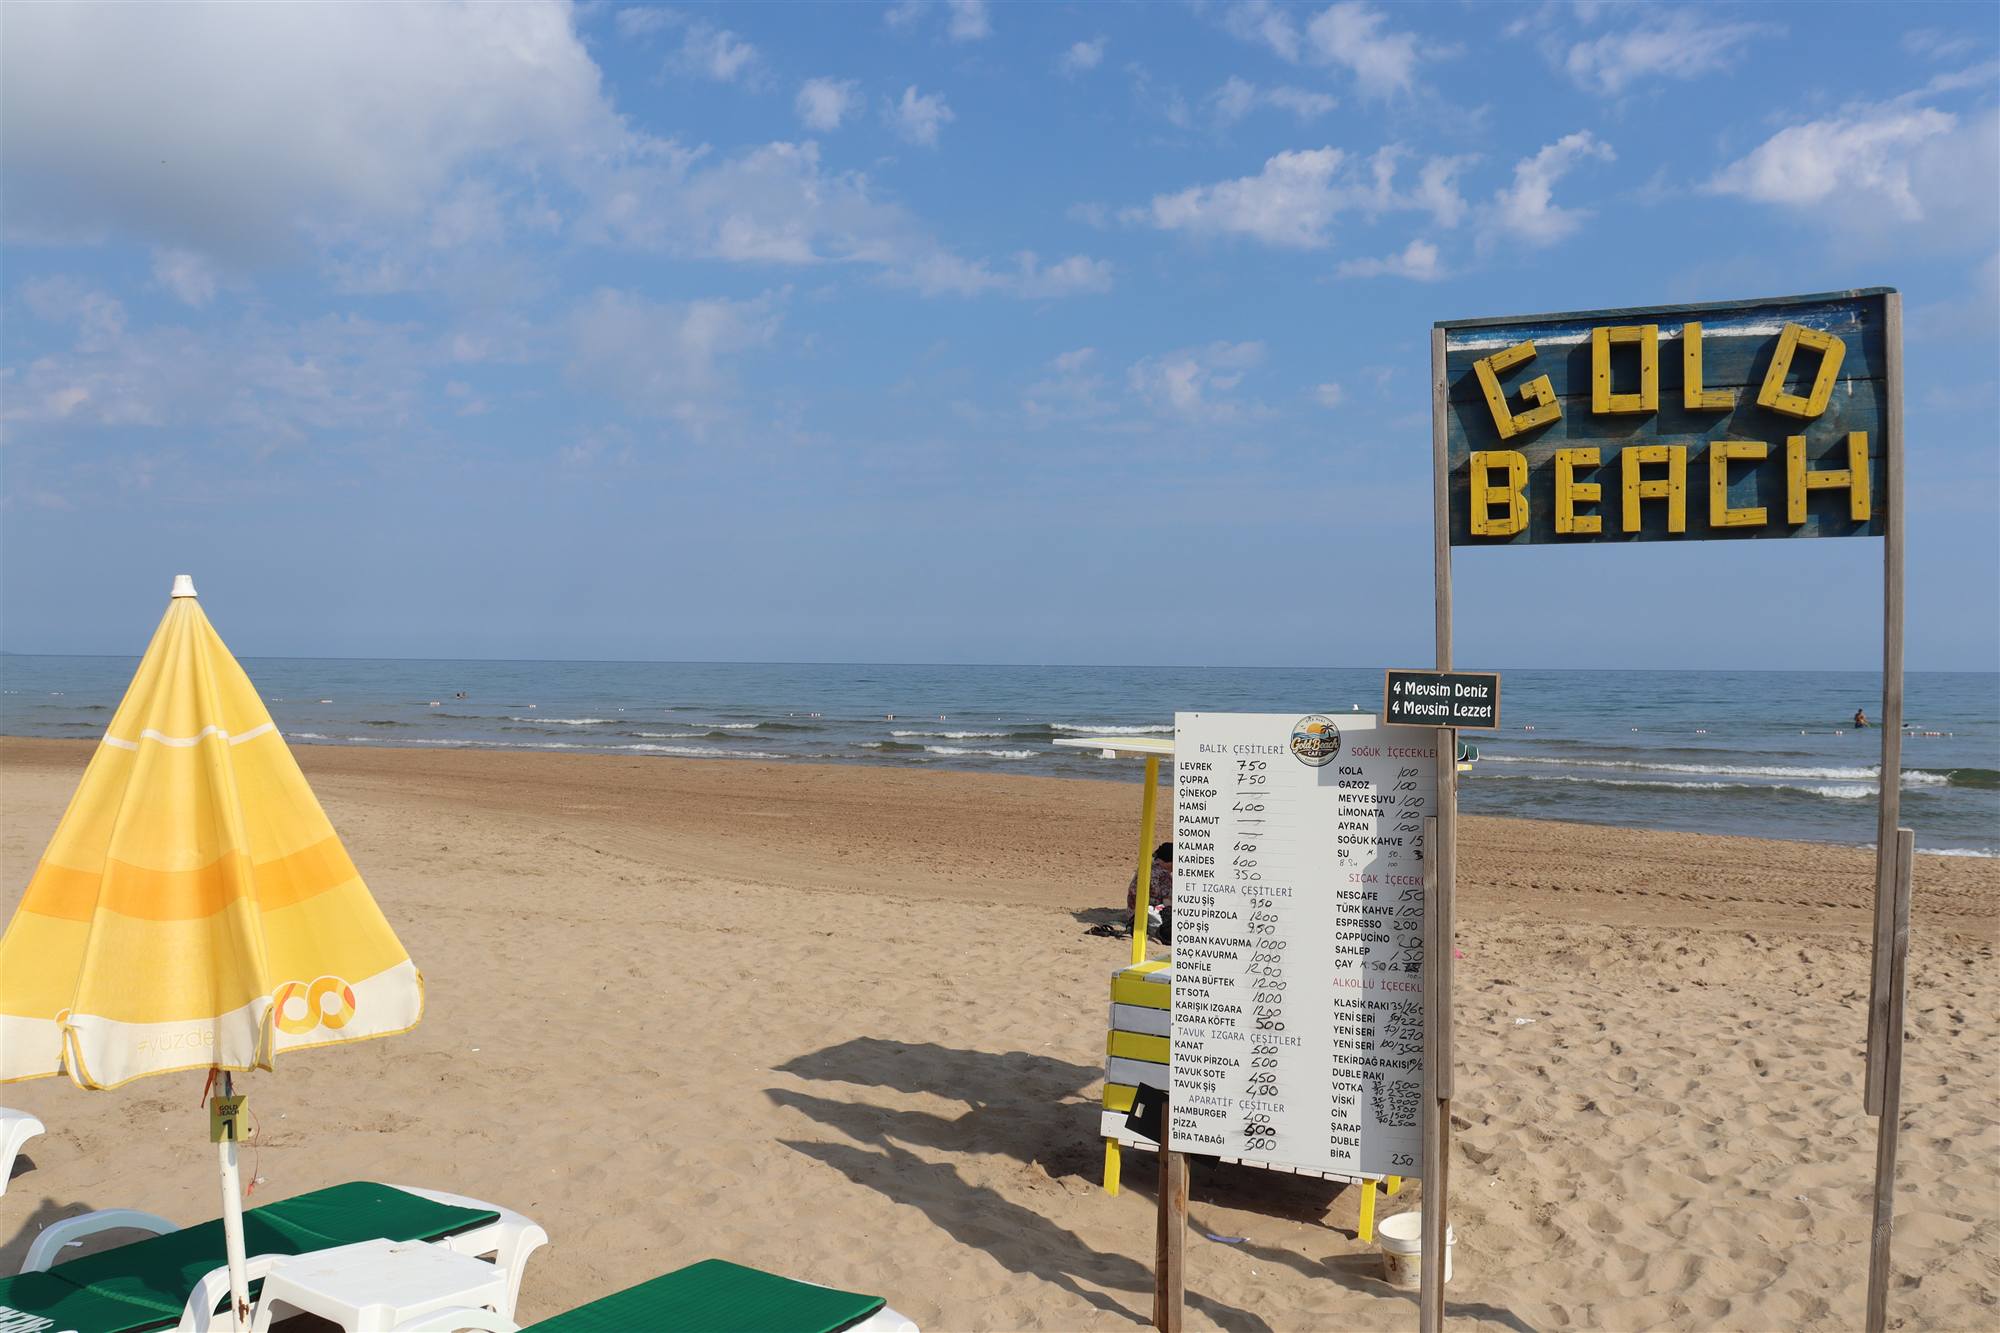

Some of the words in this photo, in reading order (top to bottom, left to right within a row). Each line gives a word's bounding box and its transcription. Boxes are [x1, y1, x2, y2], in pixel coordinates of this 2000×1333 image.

[1473, 320, 1846, 440] GOLD
[1470, 430, 1871, 537] BEACH
[1393, 681, 1401, 695] 4
[1405, 681, 1451, 697] Mevsim
[1455, 683, 1488, 698] Deniz
[1392, 700, 1400, 714] 4
[1403, 701, 1449, 716] Mevsim
[1453, 702, 1492, 718] Lezzet
[1200, 744, 1227, 753] BALIK
[1233, 743, 1284, 756] ÇEŞİTLERİ
[1352, 747, 1380, 757] SOĞUK
[1387, 747, 1438, 758] İÇECEKLE
[1180, 762, 1212, 771] LEVREK
[1237, 760, 1267, 771] 750
[1180, 775, 1209, 785] ÇUPRA
[1237, 773, 1266, 785] 750
[1338, 767, 1363, 776] KOLA
[1397, 767, 1418, 779] 100
[1338, 780, 1370, 790] GAZOZ
[1393, 781, 1417, 792] 100
[1180, 787, 1217, 798] ÇİNEKOP
[1338, 794, 1369, 803] MEYVE
[1371, 795, 1396, 804] SUYU
[1398, 795, 1425, 807] 100
[1179, 801, 1207, 811] HAMSİ
[1232, 801, 1264, 813] 400
[1338, 806, 1385, 818] LİMONATA
[1395, 809, 1420, 819] 100
[1179, 815, 1220, 825] PALAMUT
[1179, 828, 1211, 838] SOMON
[1338, 822, 1369, 831] AYRAN
[1393, 822, 1419, 832] 100
[1337, 834, 1369, 845] SOĞUK
[1371, 837, 1403, 846] KAHVE
[1178, 842, 1214, 851] KALMAR
[1233, 841, 1257, 852] 600
[1337, 849, 1350, 858] SU
[1178, 854, 1215, 865] KARİDES
[1233, 855, 1257, 867] 600
[1178, 868, 1215, 878] B.EKMEK
[1233, 869, 1261, 880] 350
[1349, 873, 1378, 884] SICAK
[1185, 882, 1197, 892] ET
[1203, 883, 1236, 894] IZGARA
[1177, 895, 1200, 904] KUZU
[1202, 895, 1215, 907] ŞİŞ
[1336, 891, 1378, 901] NESCAFE
[1177, 908, 1200, 918] KUZU
[1201, 908, 1238, 920] PİRZOLA
[1336, 903, 1360, 914] TÜRK
[1362, 906, 1394, 916] KAHVE
[1177, 920, 1195, 932] ÇÖP
[1196, 921, 1210, 933] ŞİŞ
[1336, 918, 1382, 929] ESPRESSO
[1393, 920, 1418, 930] 200
[1177, 935, 1207, 945] ÇOBAN
[1208, 937, 1252, 948] KAVURMA
[1256, 938, 1287, 950] 1000
[1335, 932, 1390, 943] CAPPUCİNO
[1176, 948, 1194, 958] SAÇ
[1195, 950, 1238, 960] KAVURMA
[1251, 951, 1281, 963] 1000
[1335, 946, 1371, 955] SAHLEP
[1176, 961, 1212, 972] BONFİLE
[1245, 963, 1282, 978] 1200
[1335, 960, 1353, 969] ÇAY
[1176, 975, 1200, 984] DANA
[1202, 975, 1235, 987] BÜFTEK
[1252, 978, 1287, 990] 1200
[1333, 977, 1375, 989] ALKOLLÜ
[1381, 979, 1422, 992] İÇECEKL
[1176, 988, 1186, 996] ET
[1187, 988, 1210, 998] SOTA
[1175, 1001, 1209, 1012] KARIŞIK
[1210, 1003, 1242, 1014] IZGARA
[1334, 998, 1365, 1009] KLASİK
[1368, 1001, 1389, 1010] RAKI
[1175, 1014, 1206, 1024] IZGARA
[1208, 1015, 1235, 1027] KÖFTE
[1255, 1018, 1285, 1031] 500
[1334, 1011, 1354, 1021] YENİ
[1356, 1013, 1375, 1023] SERİ
[1178, 1027, 1205, 1037] TAVUK
[1211, 1030, 1245, 1041] IZGARA
[1250, 1033, 1302, 1046] ÇEŞİTLERİ
[1334, 1025, 1354, 1035] YENİ
[1355, 1027, 1375, 1037] SERİ
[1174, 1040, 1204, 1050] KANAT
[1251, 1045, 1278, 1055] 500
[1334, 1039, 1354, 1048] YENİ
[1355, 1041, 1374, 1050] SERİ
[1174, 1053, 1202, 1063] TAVUK
[1204, 1055, 1240, 1067] PİRZOLA
[1251, 1058, 1278, 1068] 500
[1333, 1054, 1378, 1066] TEKİRDAĞ
[1380, 1059, 1409, 1069] RAKISI
[1174, 1066, 1202, 1076] TAVUK
[1203, 1069, 1226, 1079] SOTE
[1248, 1072, 1276, 1084] 450
[1333, 1068, 1361, 1078] DUBLE
[1363, 1071, 1385, 1080] RAKI
[1174, 1080, 1202, 1090] TAVUK
[1203, 1082, 1216, 1093] ŞİŞ
[1246, 1085, 1279, 1099] 400
[1332, 1082, 1364, 1092] VOTKA
[1188, 1095, 1233, 1107] APARATİF
[1332, 1094, 1355, 1105] VİSKİ
[1173, 1106, 1227, 1119] HAMBURGER
[1243, 1111, 1270, 1123] 400
[1331, 1107, 1347, 1118] CİN
[222, 1119, 233, 1139] 1
[1173, 1117, 1198, 1128] PİZZA
[1244, 1123, 1276, 1136] 500
[1331, 1122, 1361, 1133] ŞARAP
[1173, 1130, 1193, 1141] BİRA
[1194, 1133, 1225, 1145] TABAĞI
[1244, 1138, 1276, 1151] 500
[1330, 1136, 1360, 1146] DUBLE
[1330, 1148, 1351, 1159] BİRA
[1392, 1154, 1414, 1166] 250
